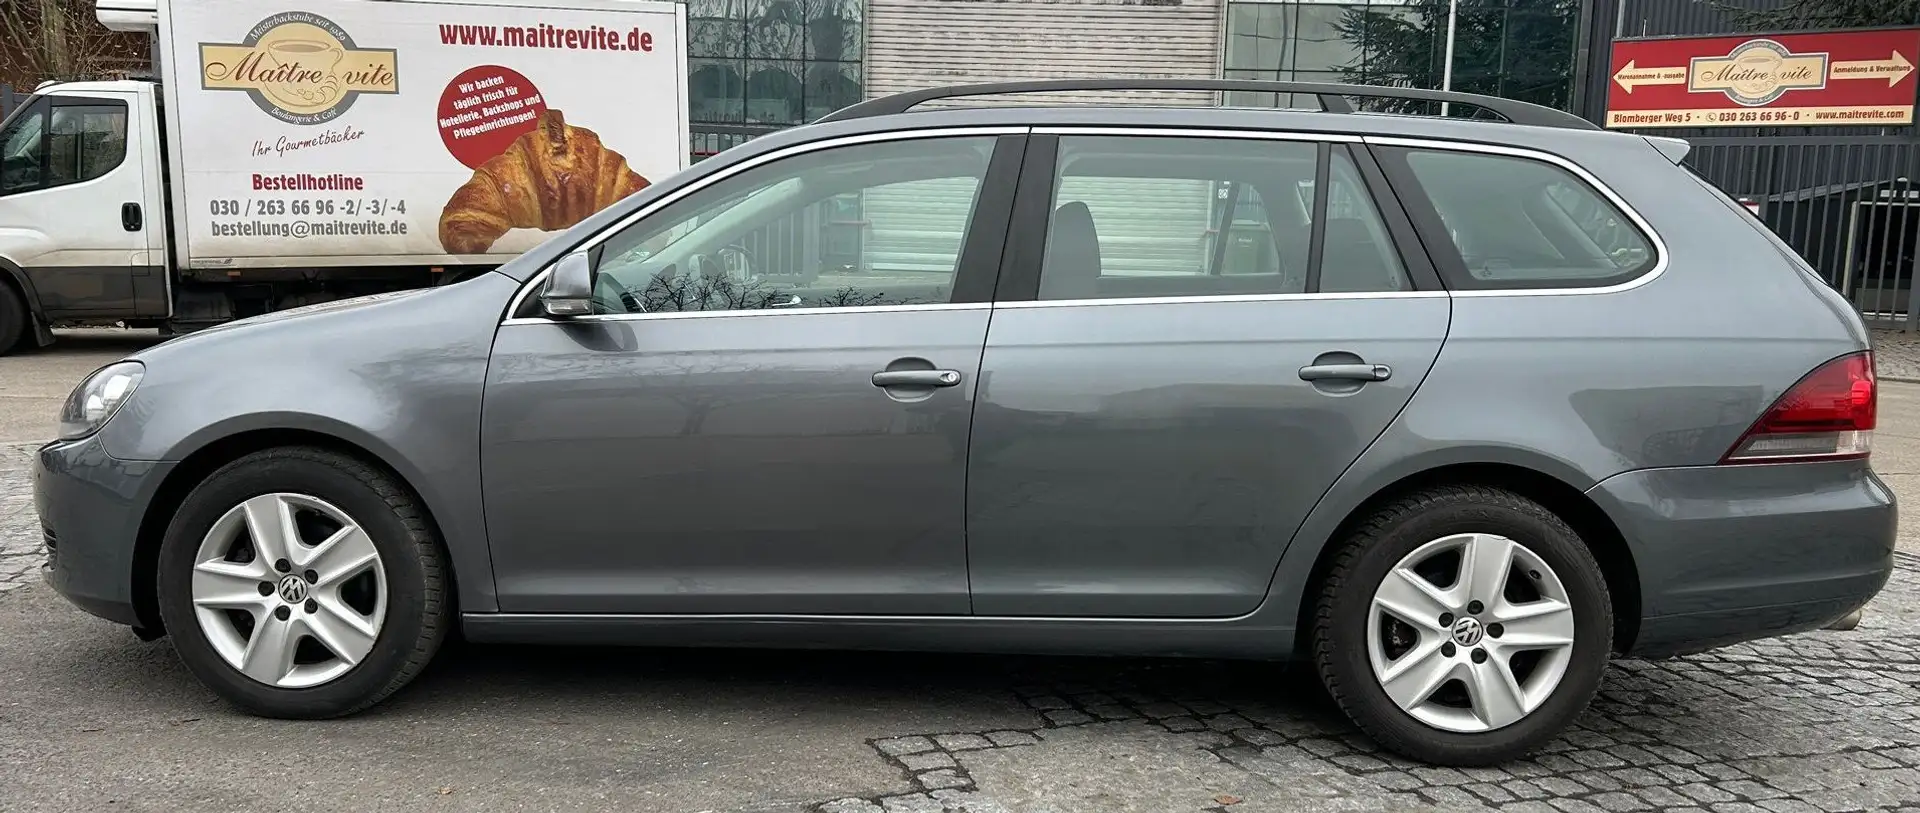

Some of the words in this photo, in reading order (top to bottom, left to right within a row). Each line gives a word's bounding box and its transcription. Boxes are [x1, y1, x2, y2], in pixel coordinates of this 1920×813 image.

[315, 19, 329, 28] seit
[439, 23, 653, 51] www.maitrevite.de
[205, 51, 323, 83] Maître
[342, 63, 394, 86] vite
[1701, 64, 1768, 82] Maître
[1780, 66, 1812, 80] vite
[459, 82, 475, 94] Wir
[475, 75, 504, 90] backen
[453, 95, 481, 110] täglich
[483, 89, 505, 103] frisch
[505, 86, 519, 97] für
[313, 113, 321, 122] &
[440, 110, 483, 129] Hotellerie,
[482, 99, 524, 118] Backshops
[525, 93, 541, 104] und
[1614, 113, 1663, 124] Blomberger
[1664, 112, 1682, 123] Weg
[1685, 112, 1691, 122] 5
[1719, 112, 1737, 122] 030
[1739, 111, 1757, 121] 263
[1759, 111, 1772, 121] 66
[1815, 109, 1905, 119] www.maitrevite.com
[453, 109, 537, 140] Pflegeeinrichtungen!
[252, 140, 272, 157] Ihr
[275, 125, 365, 158] Gourmetbäcker
[252, 173, 363, 191] Bestellhotline
[210, 199, 240, 216] 030
[257, 199, 285, 215] 263
[291, 199, 310, 215] 66
[315, 199, 334, 215] 96
[391, 199, 406, 215] -4
[211, 220, 407, 239] bestellung@maitrevite.de
